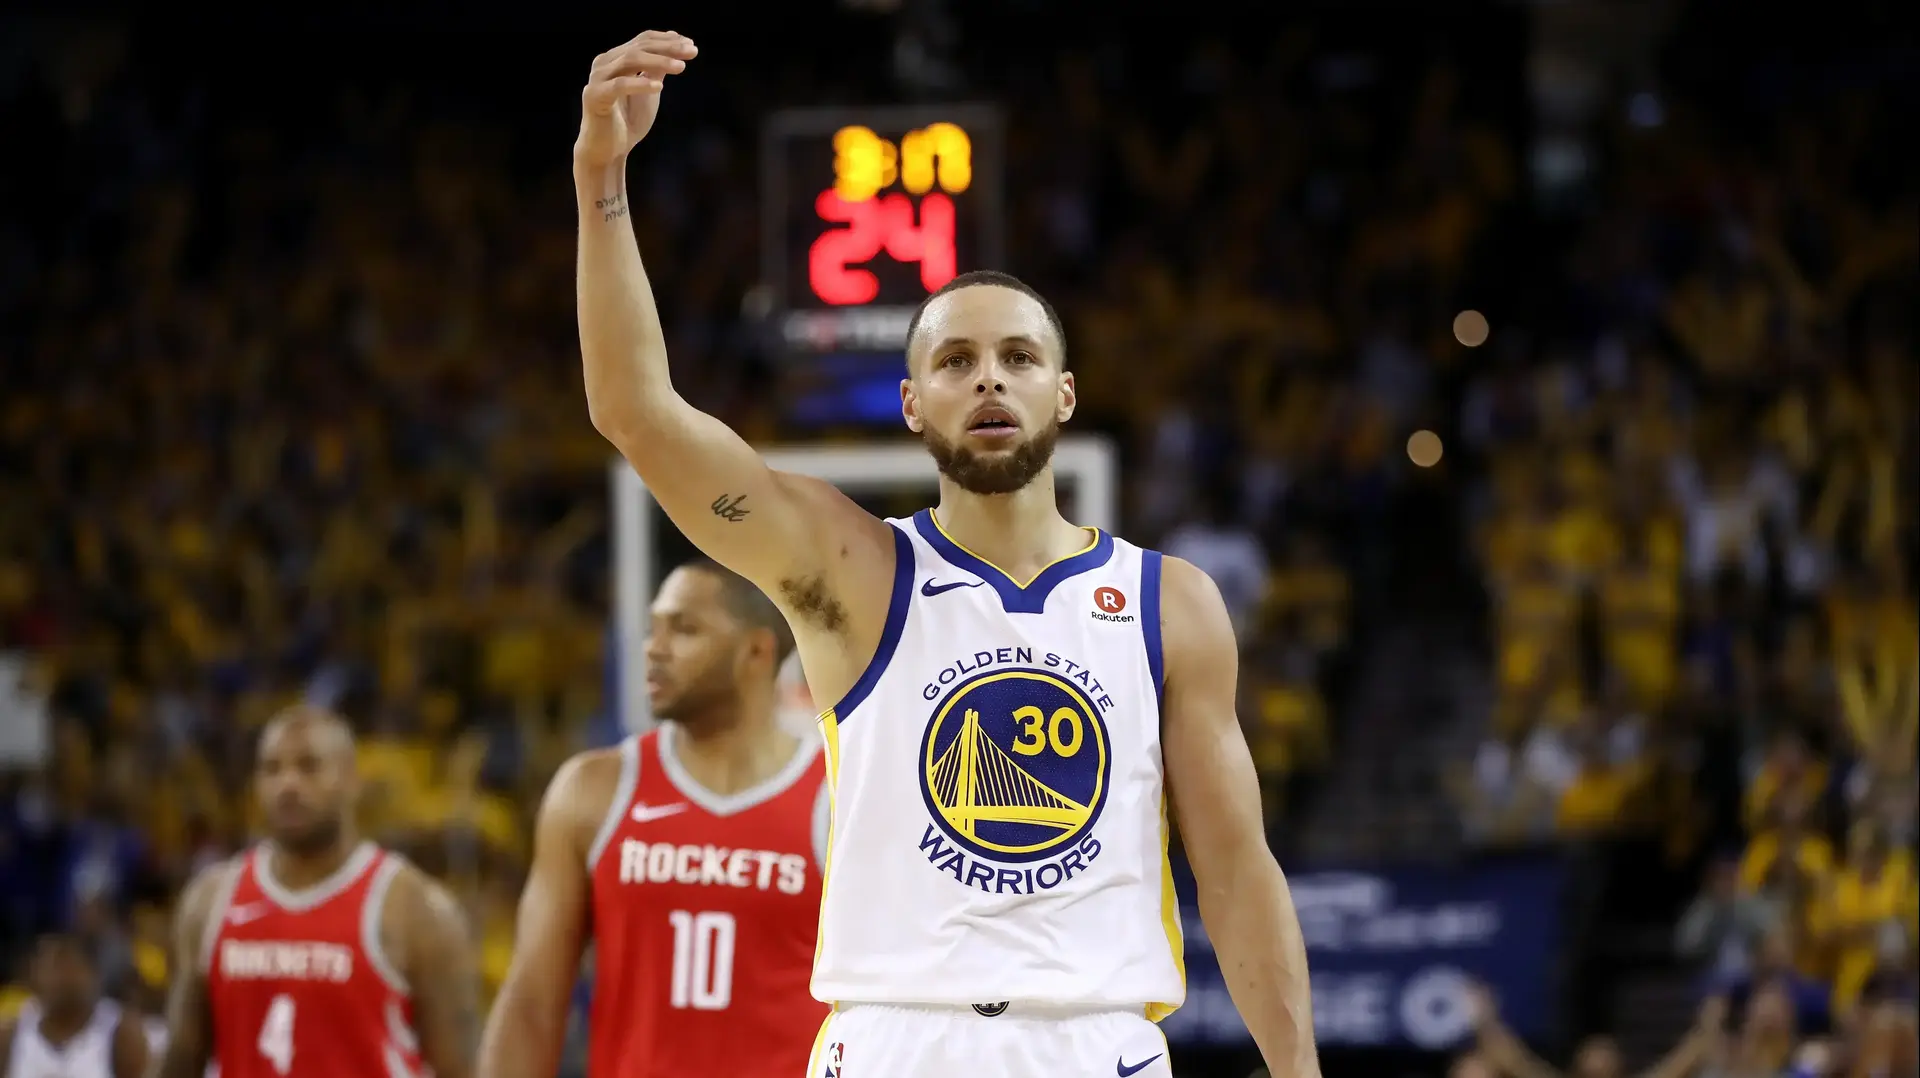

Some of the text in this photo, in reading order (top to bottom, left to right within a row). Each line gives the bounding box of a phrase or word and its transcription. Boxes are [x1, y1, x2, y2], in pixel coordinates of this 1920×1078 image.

[809, 192, 957, 305] 24
[1091, 611, 1134, 623] Rakuten
[1102, 592, 1119, 609] R
[922, 646, 1114, 713] GOLDEN STATE
[1011, 705, 1084, 758] 30
[619, 836, 807, 895] ROCKETS
[918, 822, 1103, 895] WARRIORS
[668, 909, 736, 1011] 10
[257, 992, 296, 1076] 4
